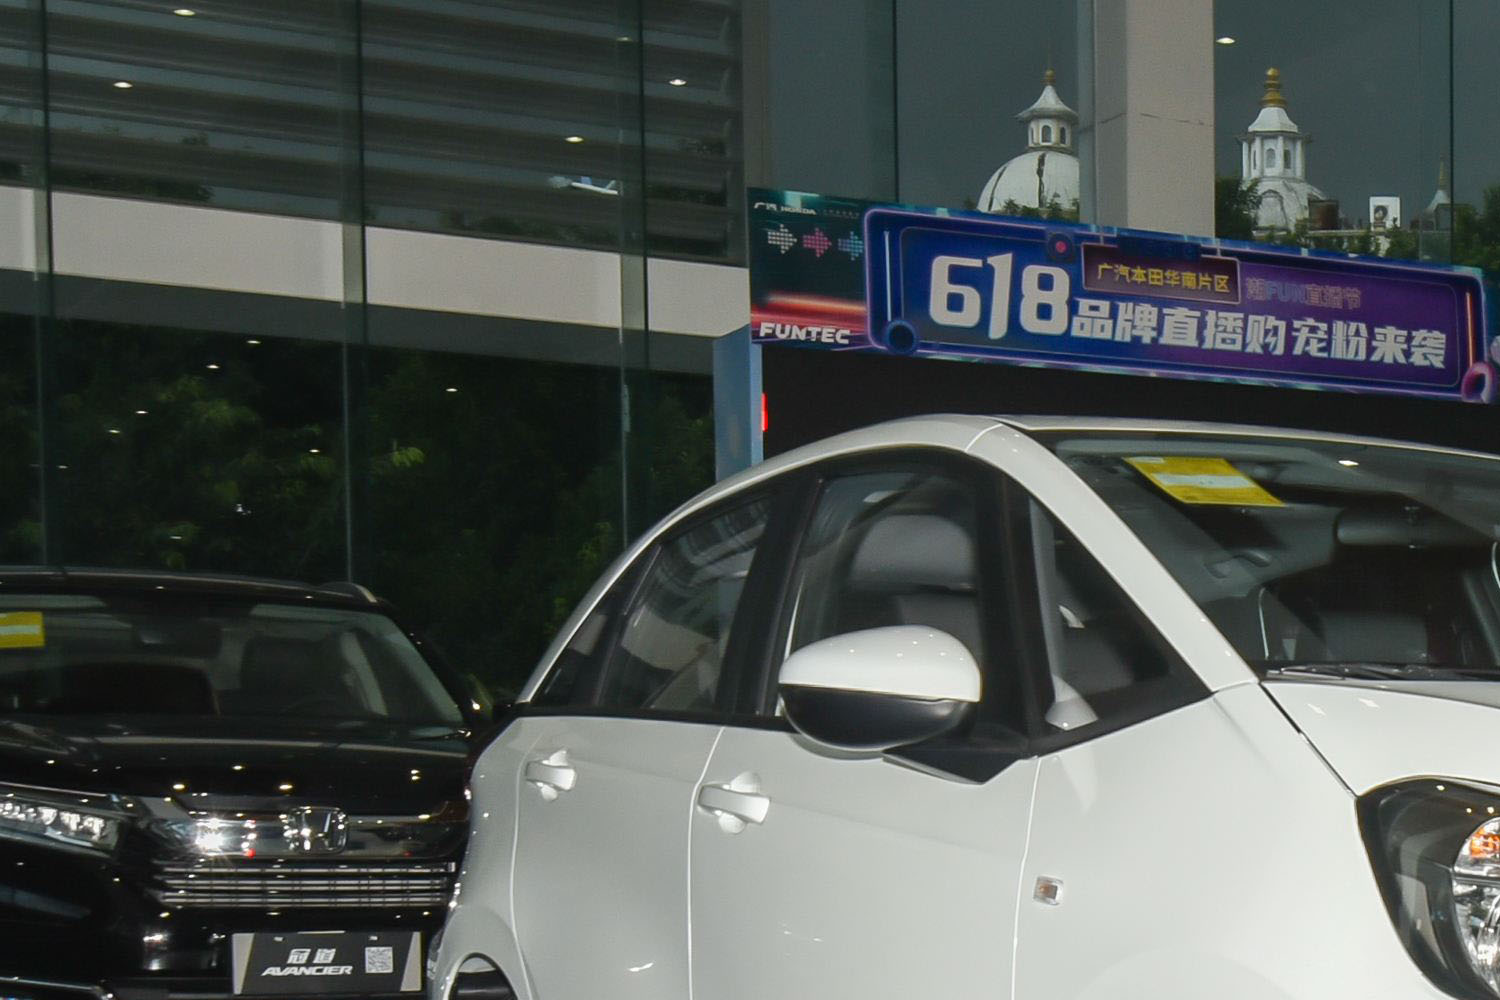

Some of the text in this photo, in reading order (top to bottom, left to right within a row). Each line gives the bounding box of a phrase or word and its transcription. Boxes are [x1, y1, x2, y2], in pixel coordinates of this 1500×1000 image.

[1097, 263, 1231, 293] 广汽本田华南片区
[929, 253, 1070, 340] 618
[760, 322, 851, 344] FUNTEC
[261, 966, 353, 976] AVANCIER
